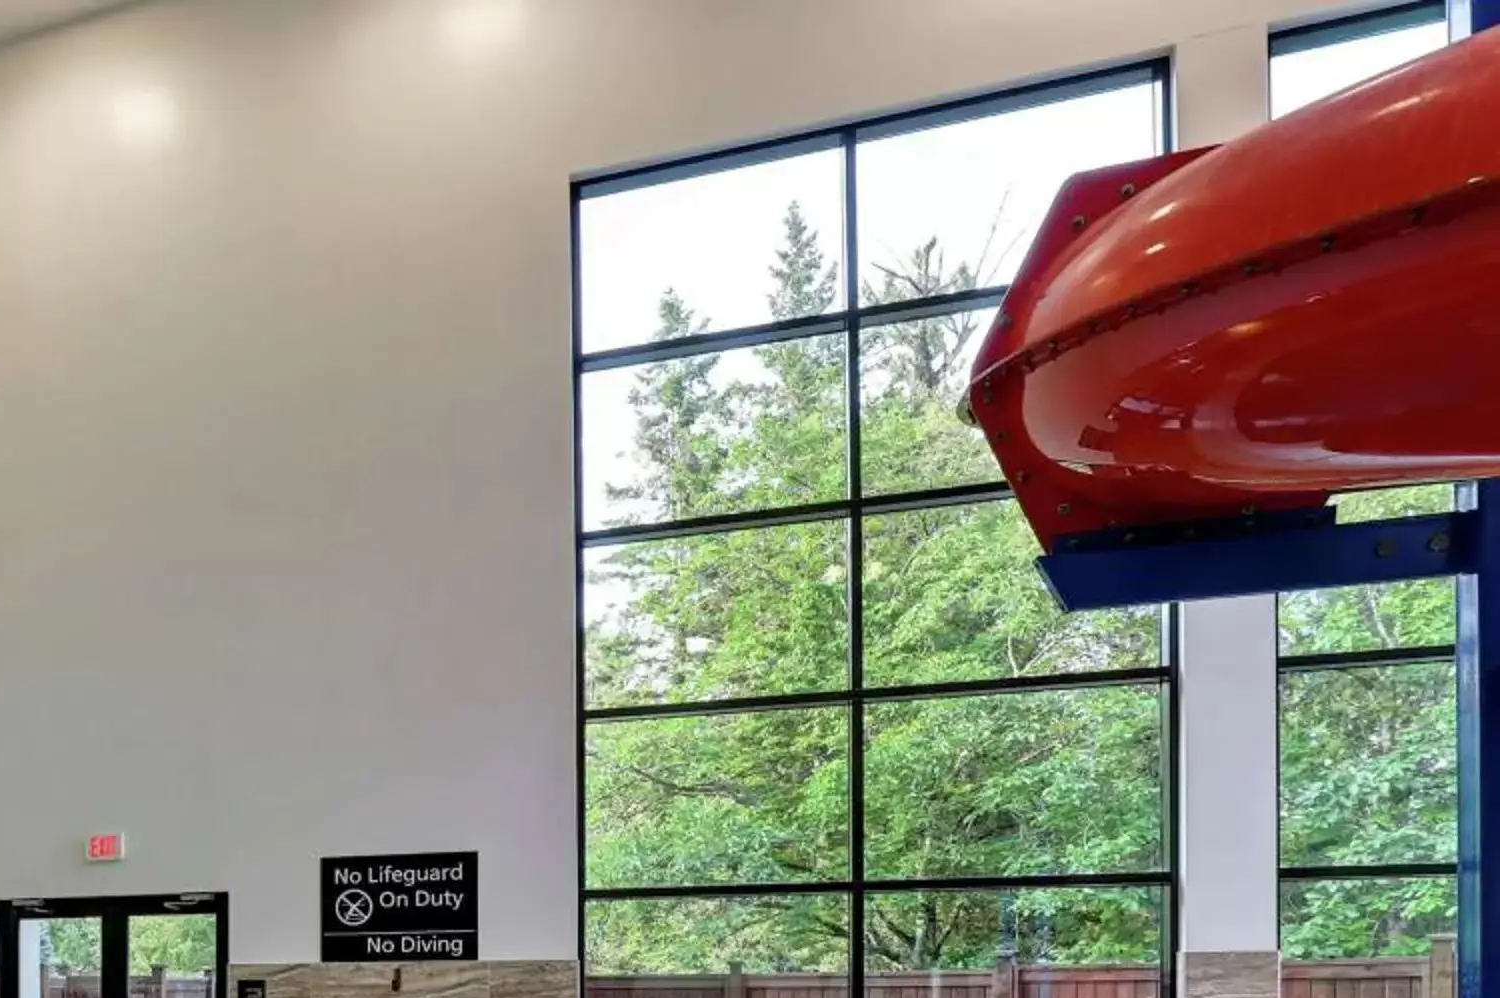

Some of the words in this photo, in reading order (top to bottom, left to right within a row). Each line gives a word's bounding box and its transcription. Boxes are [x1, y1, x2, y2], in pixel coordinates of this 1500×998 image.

[334, 868, 362, 885] No
[368, 862, 463, 886] Lifeguard
[379, 891, 409, 908] On
[415, 889, 464, 911] Duty
[367, 937, 395, 954] No
[401, 935, 463, 957] Diving
